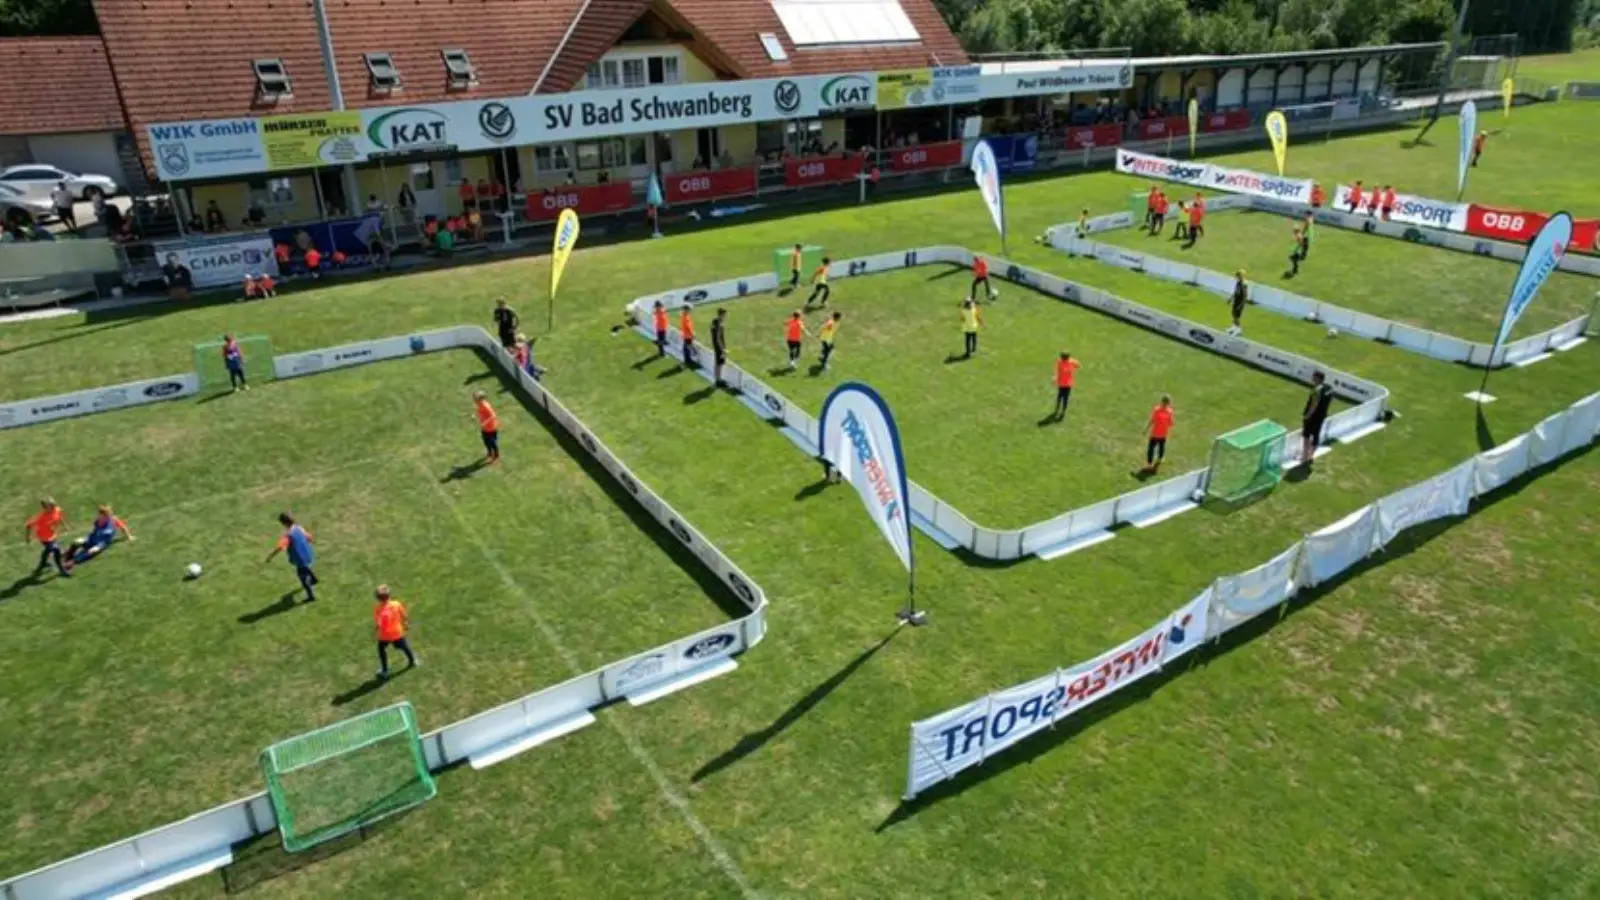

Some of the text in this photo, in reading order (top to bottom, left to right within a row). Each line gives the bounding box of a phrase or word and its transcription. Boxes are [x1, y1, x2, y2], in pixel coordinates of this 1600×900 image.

[835, 87, 871, 103] KAT
[544, 90, 752, 130] SV Bad Schwanberg
[150, 121, 257, 140] WIK GmbH
[391, 120, 446, 145] KAT
[1133, 157, 1204, 180] INTERSPORT
[1224, 170, 1304, 196] INTERSPORT
